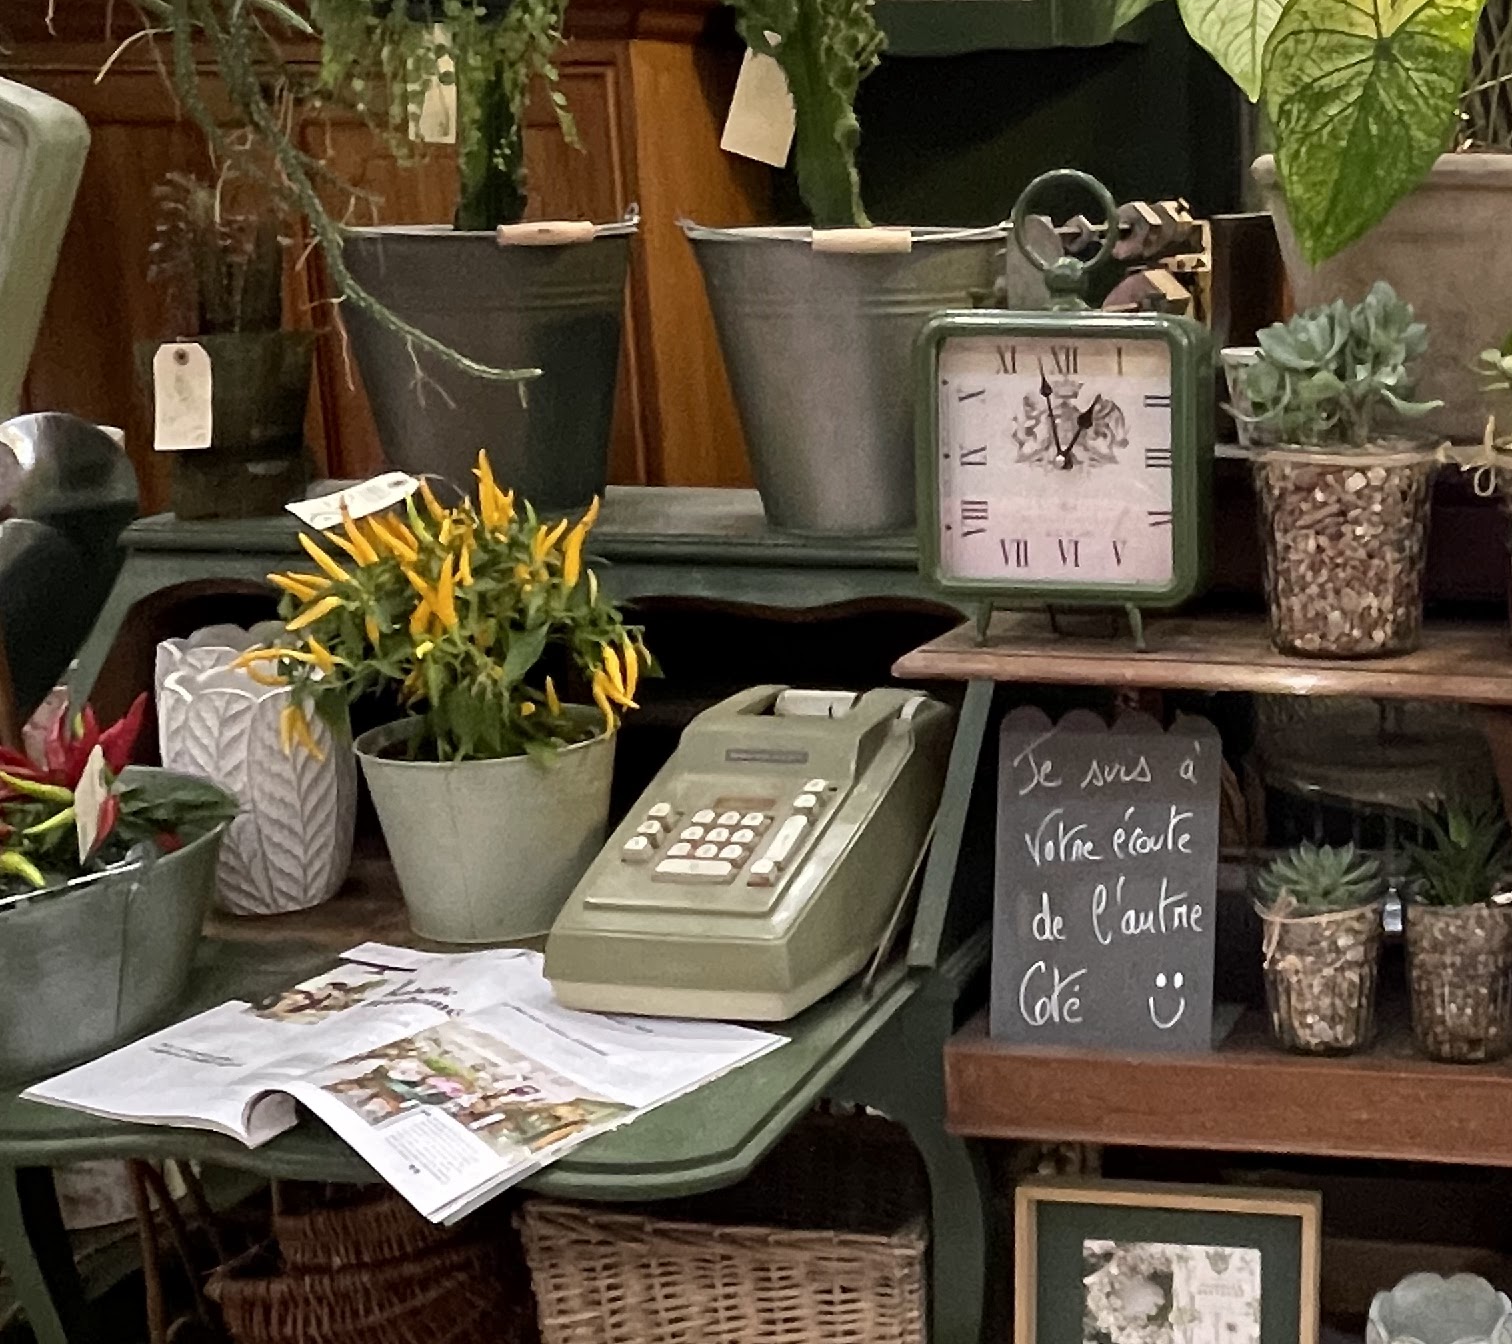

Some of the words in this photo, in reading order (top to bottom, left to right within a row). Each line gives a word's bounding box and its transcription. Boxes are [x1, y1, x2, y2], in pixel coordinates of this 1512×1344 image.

[996, 344, 1017, 375] XI
[1050, 344, 1079, 375] XII
[1116, 345, 1124, 376] I
[1144, 394, 1171, 408] II
[1144, 448, 1172, 469] III
[960, 500, 989, 538] VIII
[1000, 537, 1029, 568] VII
[1057, 537, 1081, 568] VI
[1111, 539, 1127, 567] V
[1012, 727, 1063, 796] Je
[1080, 755, 1152, 789] suis
[1179, 739, 1201, 784] à
[1112, 804, 1195, 860] écoute
[1031, 891, 1067, 943] de
[1092, 872, 1203, 946] l'autre
